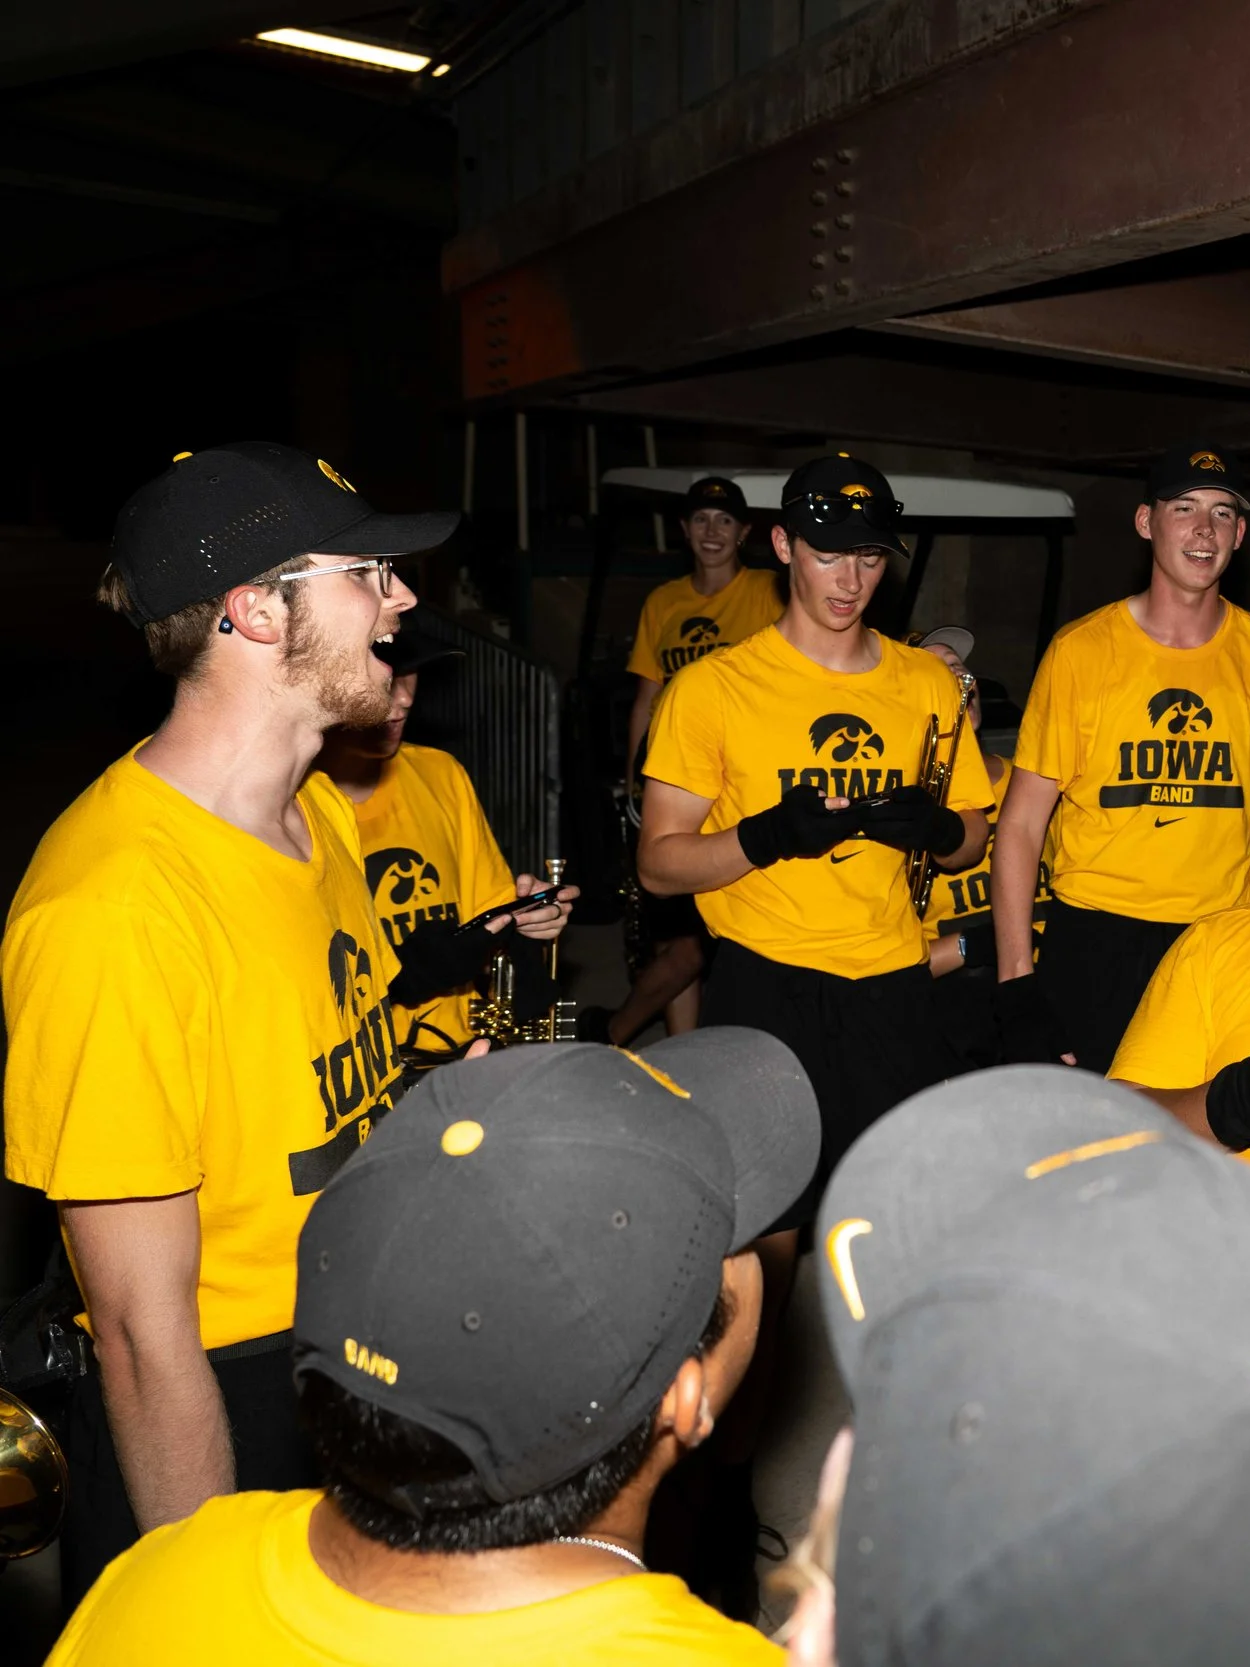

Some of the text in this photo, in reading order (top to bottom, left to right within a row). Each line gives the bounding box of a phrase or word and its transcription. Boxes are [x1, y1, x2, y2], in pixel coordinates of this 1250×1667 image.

[1118, 739, 1233, 781] IOWA
[1150, 785, 1194, 803] BAND
[947, 859, 1052, 915] IOA
[344, 1338, 398, 1385] BAND
